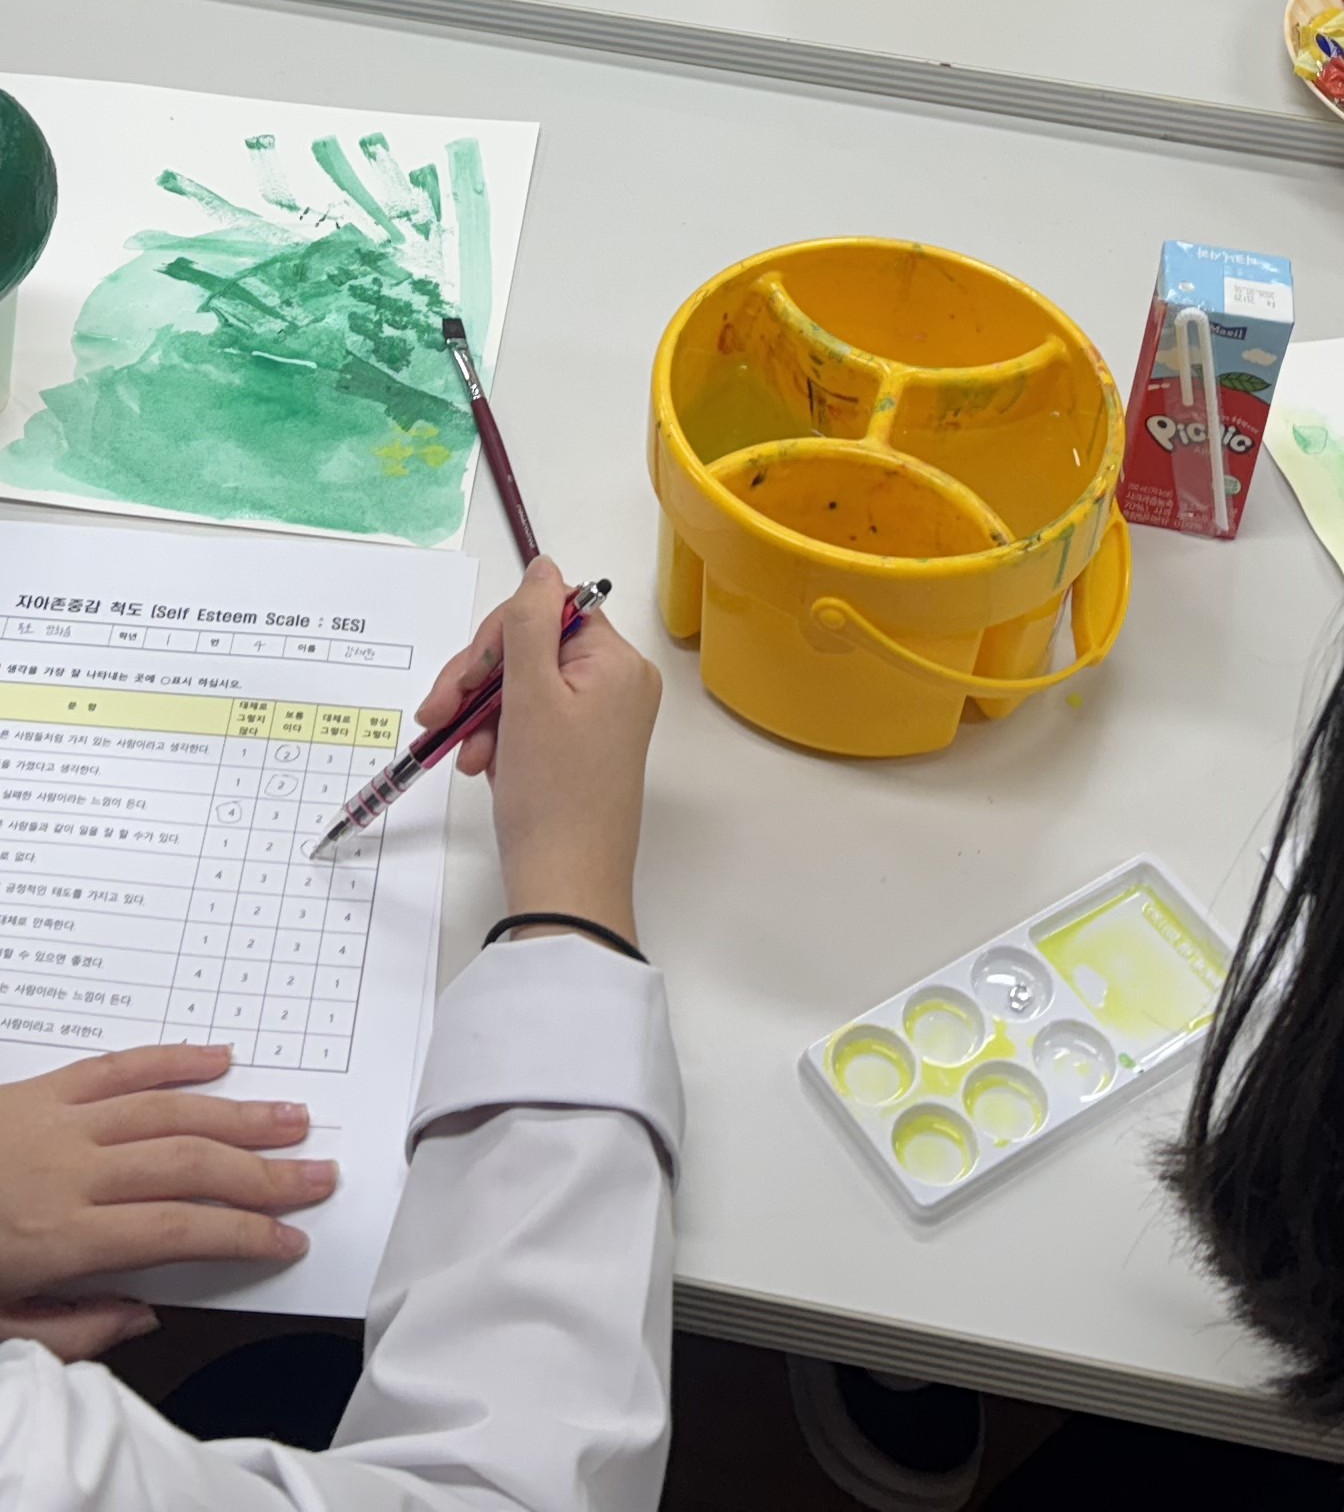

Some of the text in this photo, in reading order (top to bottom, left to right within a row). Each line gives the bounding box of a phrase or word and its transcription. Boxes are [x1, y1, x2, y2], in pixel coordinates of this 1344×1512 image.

[15, 594, 101, 614] 자아존중감
[109, 600, 143, 617] 척도
[196, 607, 258, 625] Esteem
[264, 611, 311, 628] Scale
[118, 630, 138, 642] 학년
[296, 643, 317, 654] 이름
[6, 663, 38, 676] 생각을
[42, 666, 66, 678] 가장
[70, 667, 82, 679] 잘
[85, 669, 129, 682] 나타내는
[133, 672, 156, 684] 곳에
